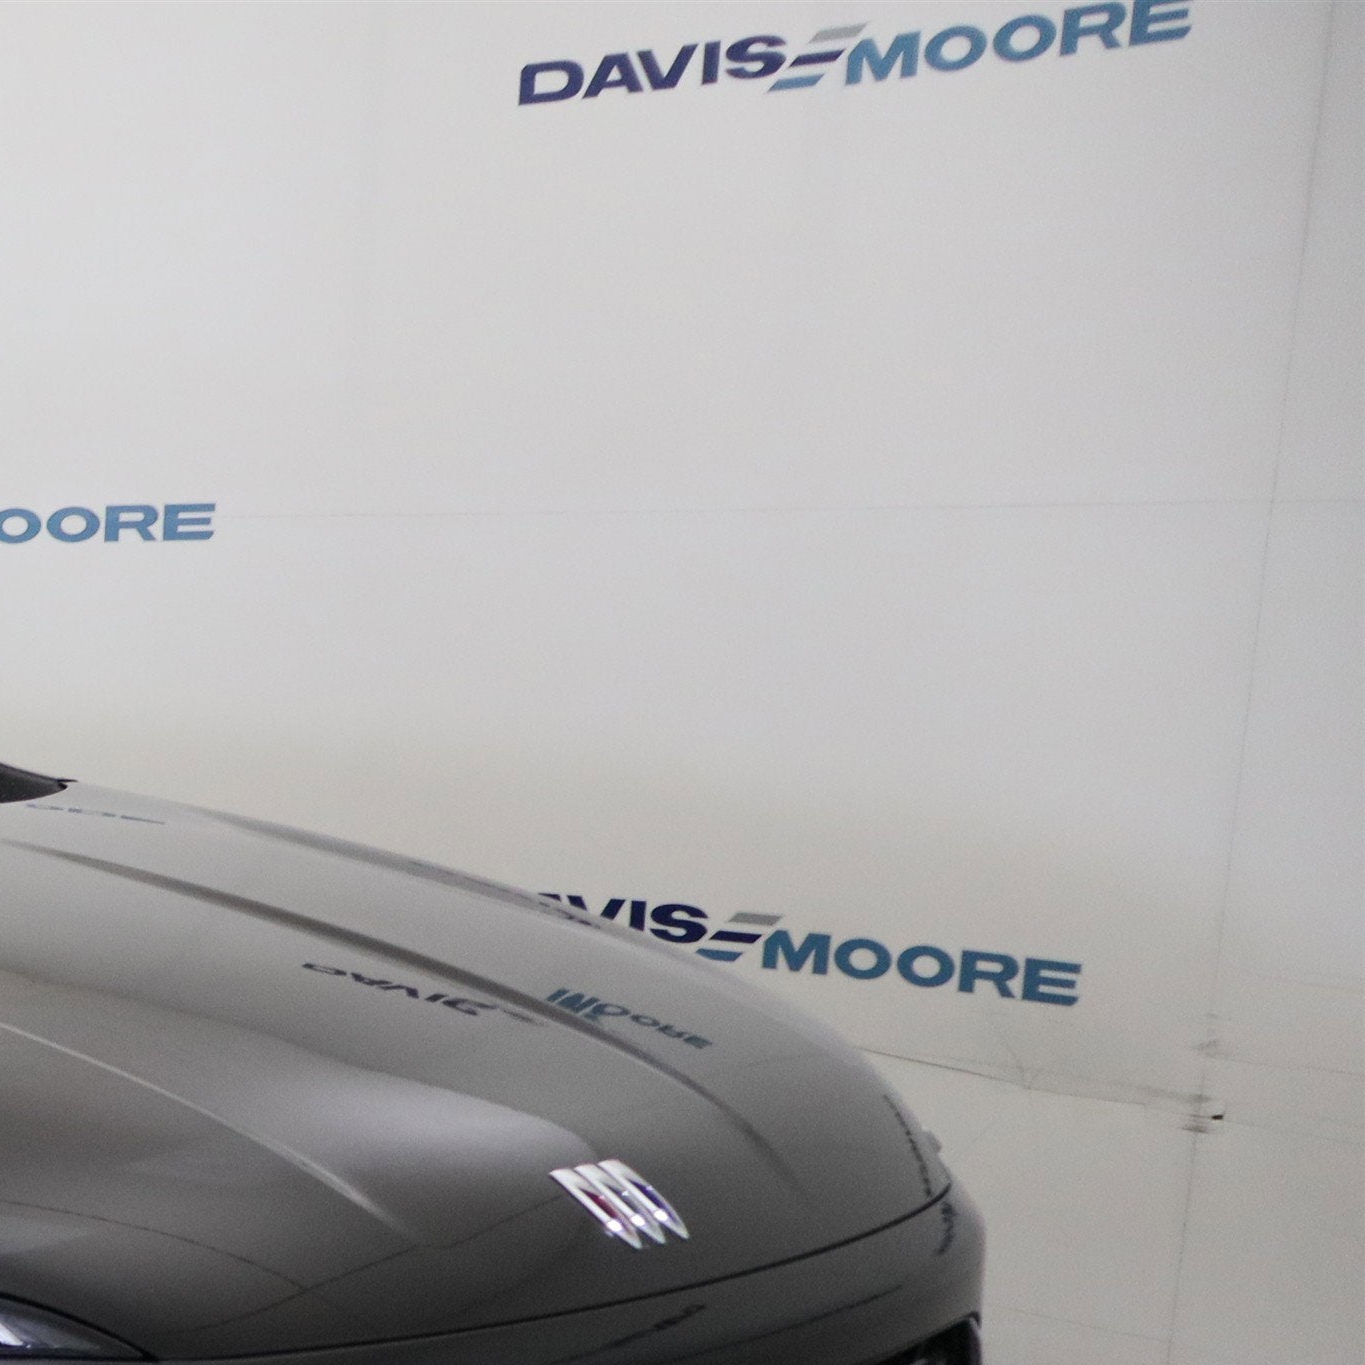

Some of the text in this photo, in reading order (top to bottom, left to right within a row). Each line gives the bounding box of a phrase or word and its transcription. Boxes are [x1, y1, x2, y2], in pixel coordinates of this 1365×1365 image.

[518, 0, 1193, 105] DAVIS MOORE
[762, 929, 1082, 1007] MOORE
